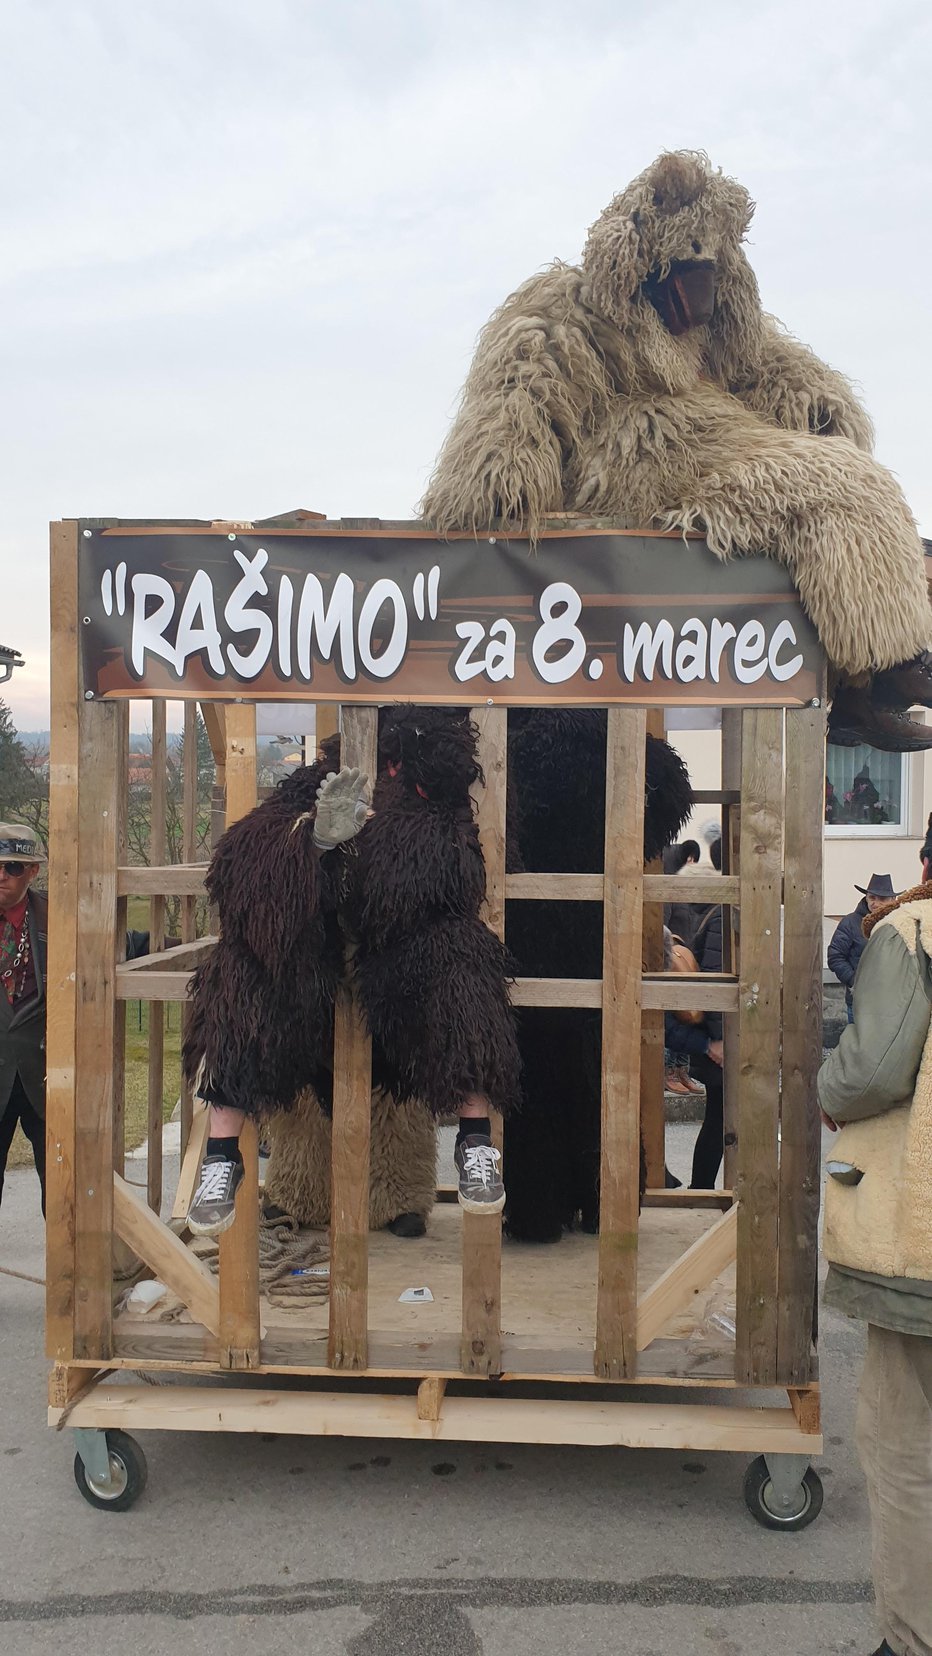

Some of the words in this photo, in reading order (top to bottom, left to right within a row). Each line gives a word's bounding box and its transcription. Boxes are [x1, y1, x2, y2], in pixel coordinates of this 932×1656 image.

[100, 548, 441, 680] "RAŠIMO"
[454, 618, 516, 682] za
[532, 582, 604, 684] 8.
[623, 617, 804, 684] marec
